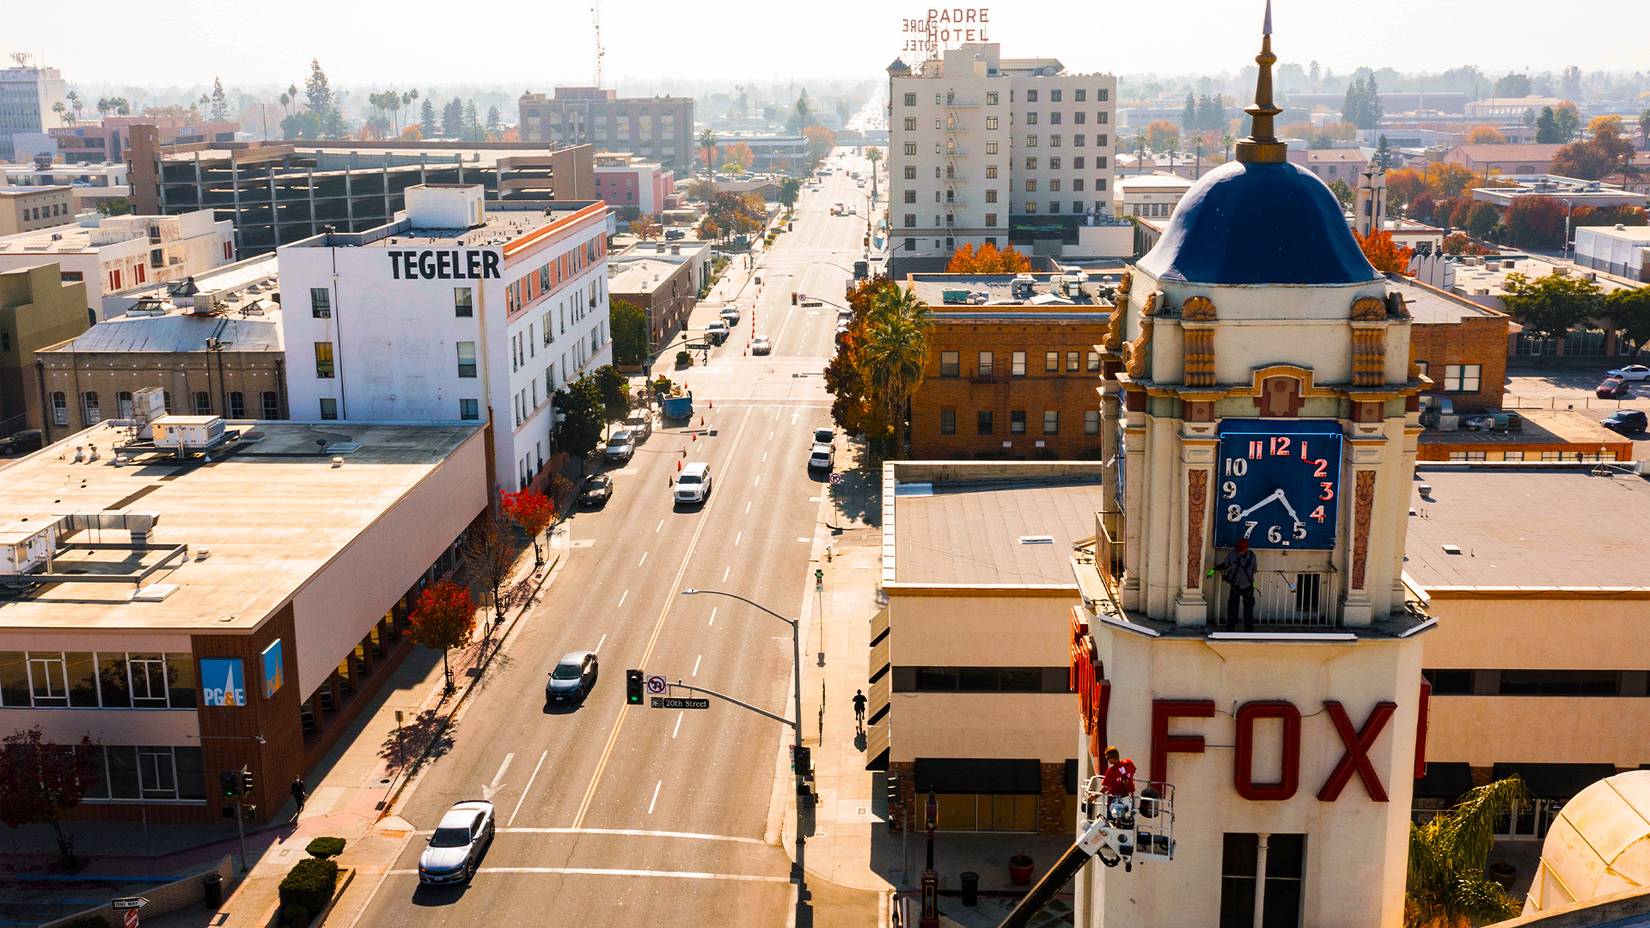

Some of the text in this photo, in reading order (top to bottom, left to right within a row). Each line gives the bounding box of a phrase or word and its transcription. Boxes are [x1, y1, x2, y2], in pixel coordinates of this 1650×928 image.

[928, 8, 989, 23] PADRE
[928, 29, 989, 42] HOTEL
[388, 250, 501, 280] TEGELER
[1249, 441, 1263, 459] 11
[1270, 436, 1291, 456] 12
[1301, 441, 1308, 459] 1
[1225, 458, 1248, 476] 10
[1313, 459, 1328, 478] 2
[1223, 481, 1237, 499] 9
[1319, 482, 1334, 501] 3
[1227, 504, 1242, 522] 8
[1309, 505, 1326, 524] 4
[1244, 521, 1258, 539] 7
[1268, 525, 1282, 543] 6
[1293, 521, 1307, 540] 5
[203, 687, 246, 706] PG&E
[665, 699, 707, 708] 20th Street
[1150, 700, 1398, 803] FOX
